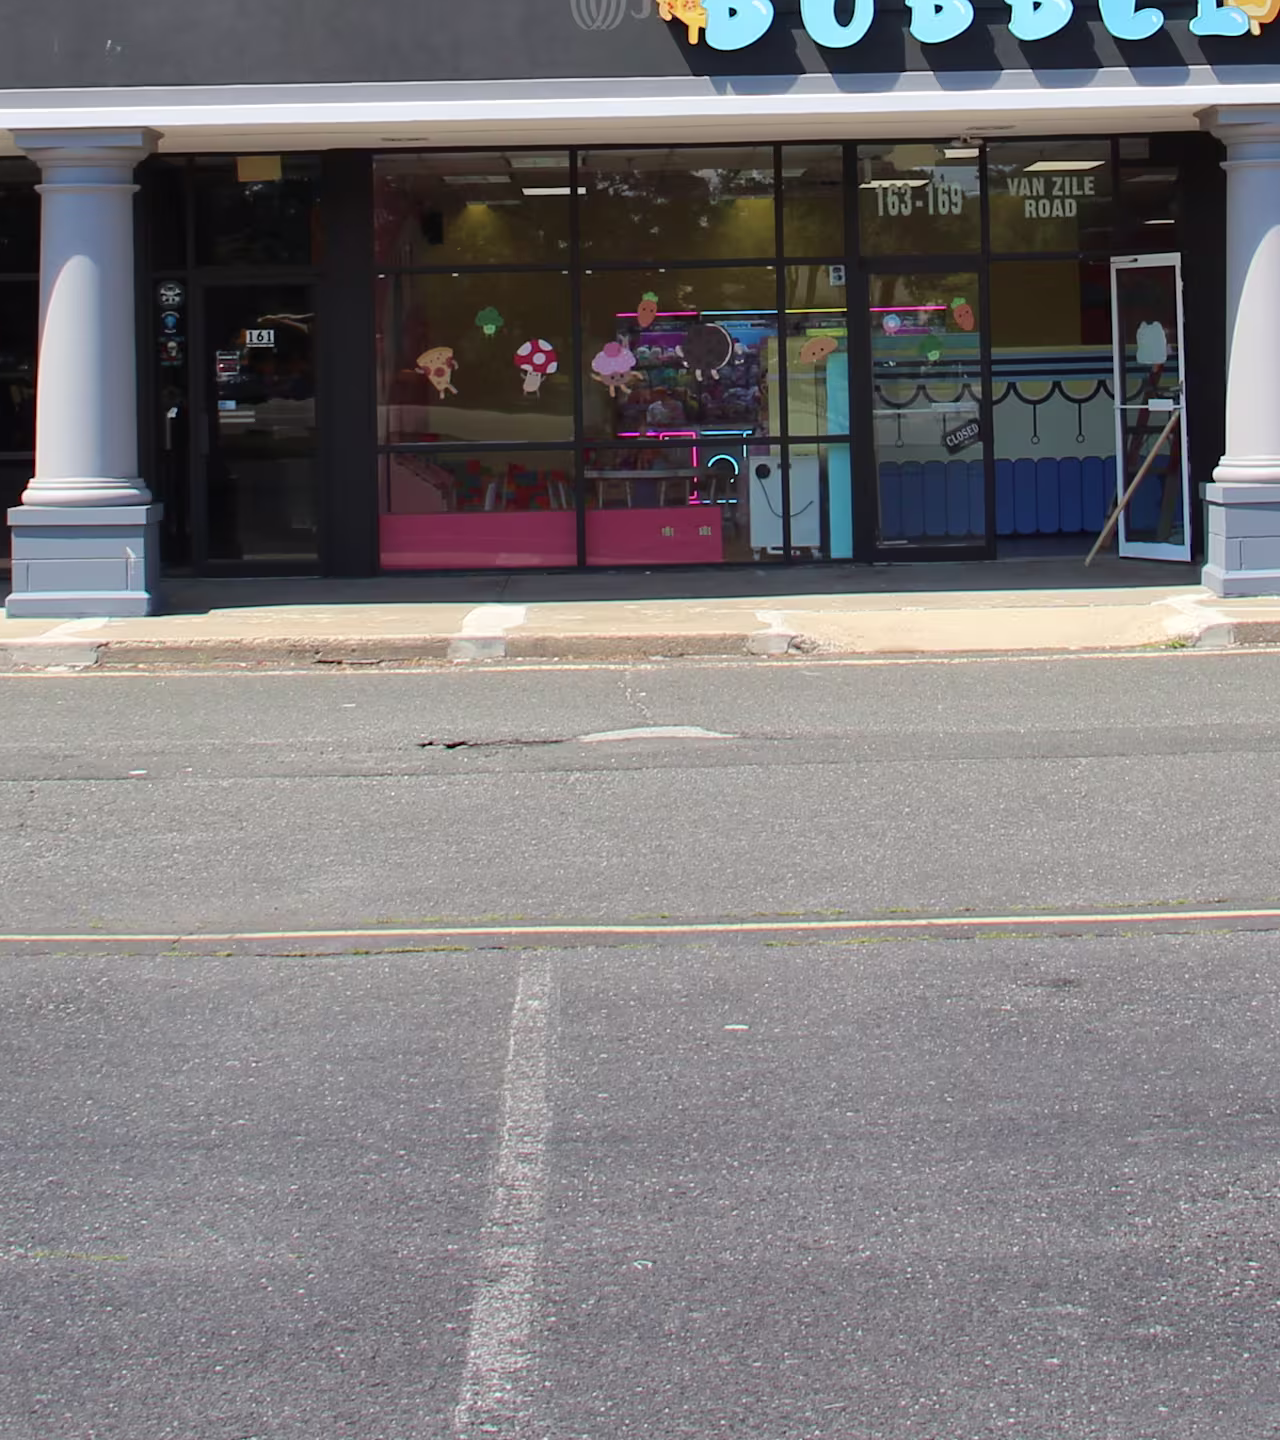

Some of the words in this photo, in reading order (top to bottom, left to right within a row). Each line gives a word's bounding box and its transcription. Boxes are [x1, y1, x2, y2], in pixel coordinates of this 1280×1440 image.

[1006, 176, 1045, 196] VAN
[1052, 175, 1096, 196] ZILE
[874, 183, 963, 217] 163-169
[1024, 198, 1077, 218] ROAD
[249, 331, 273, 342] 161
[946, 423, 980, 447] CLOSED
